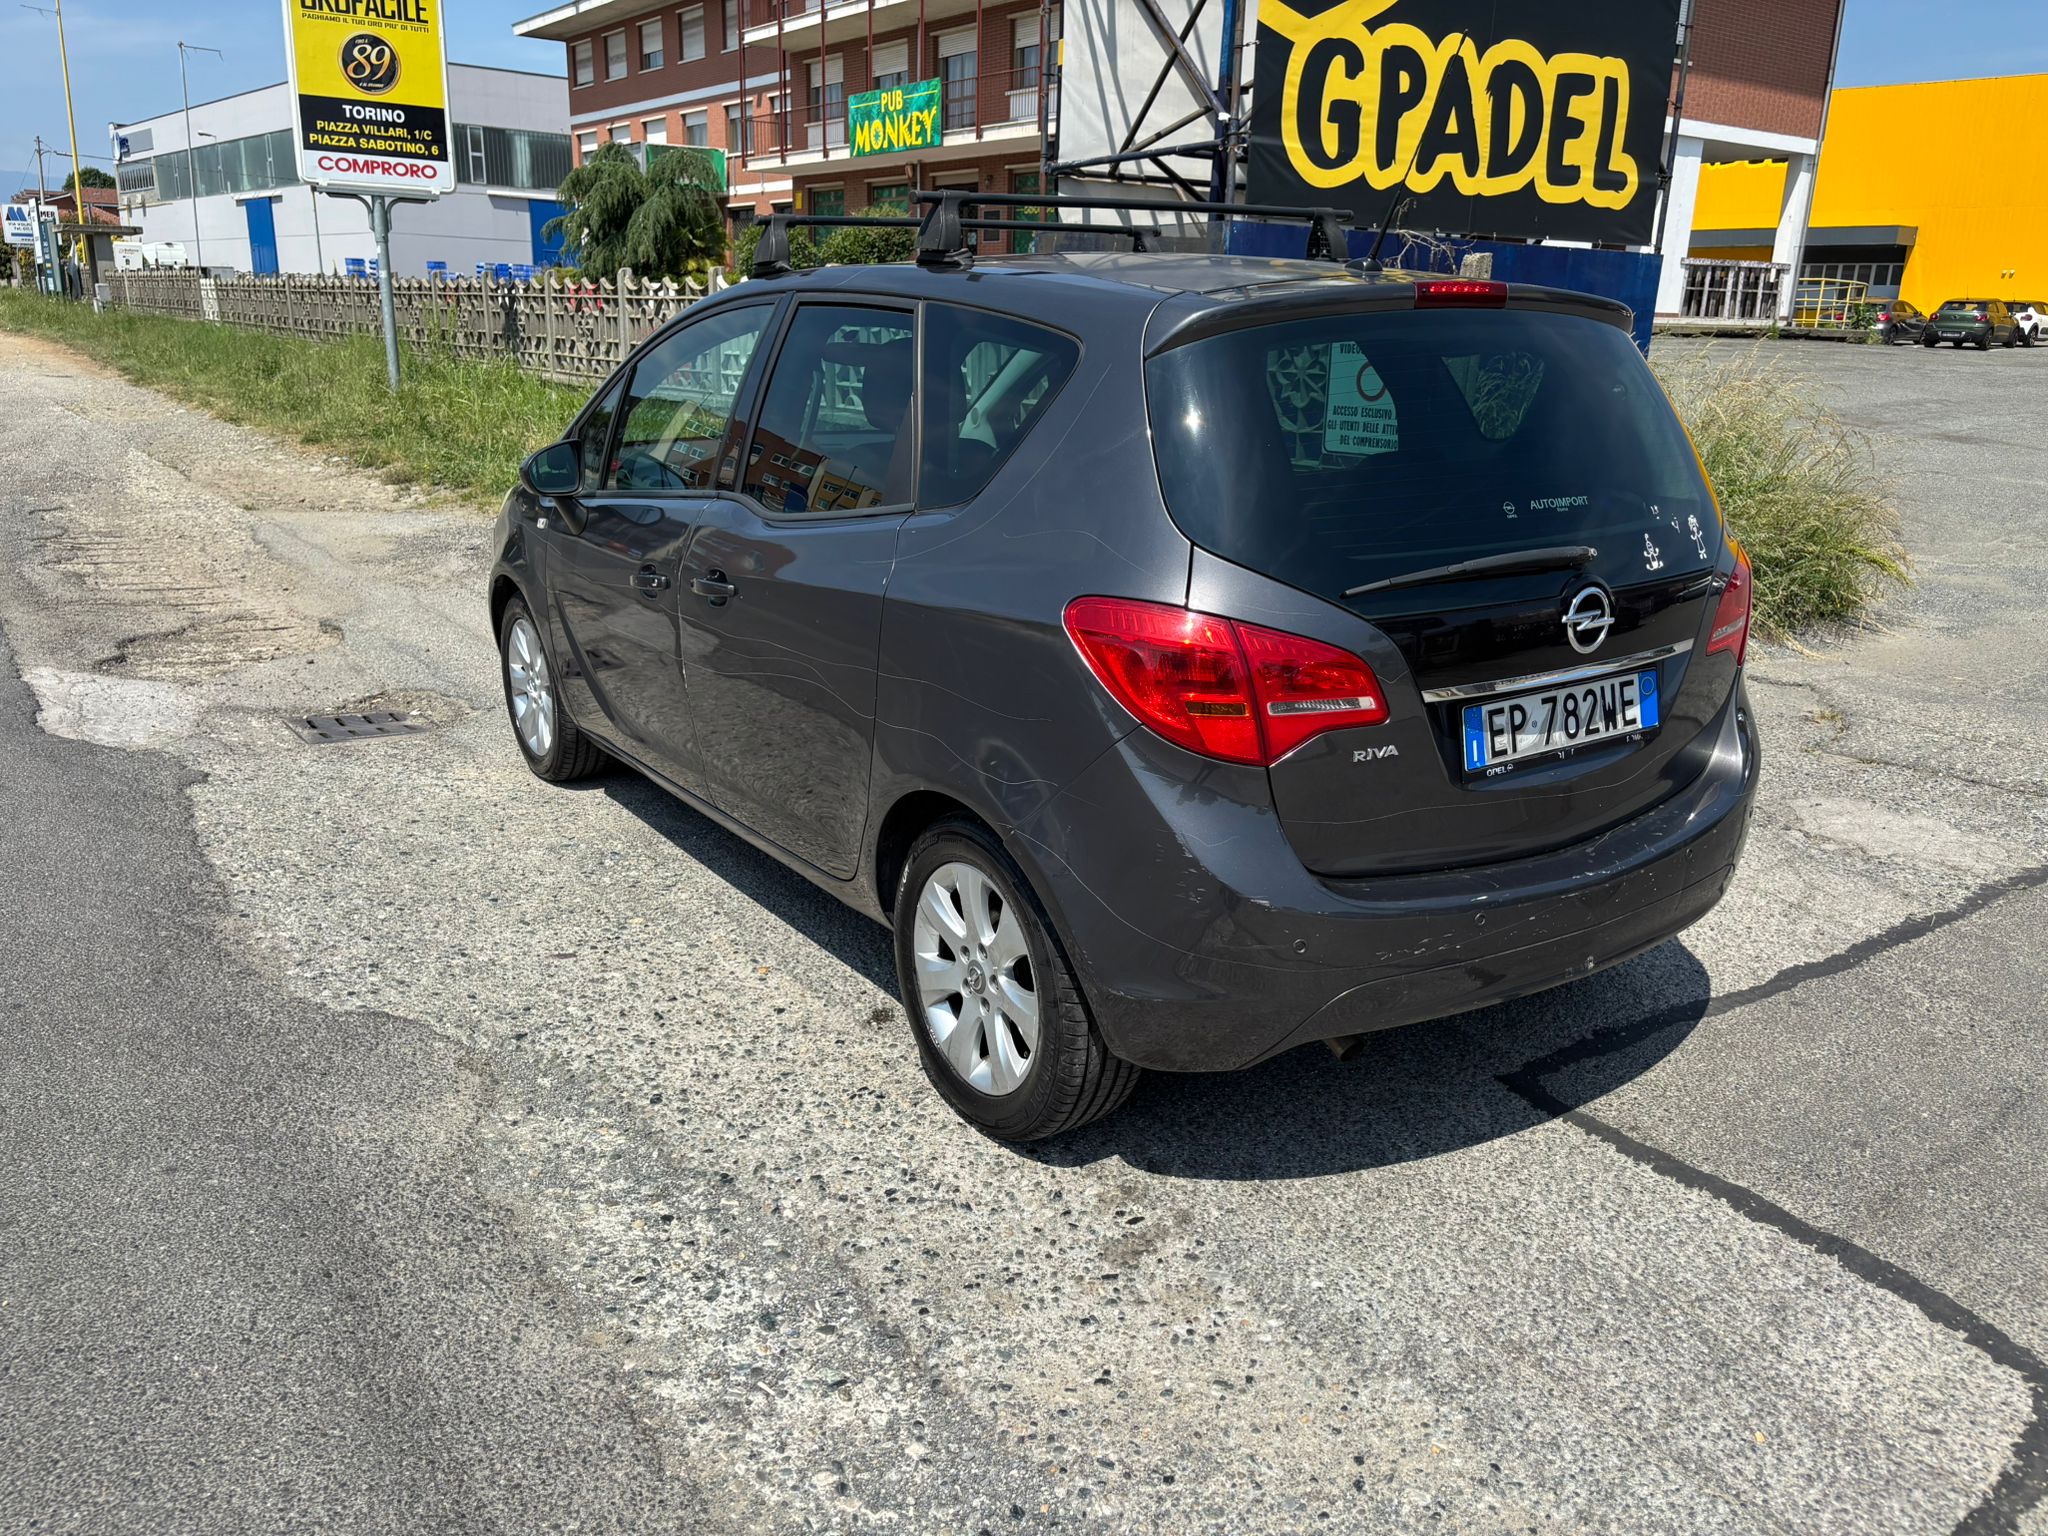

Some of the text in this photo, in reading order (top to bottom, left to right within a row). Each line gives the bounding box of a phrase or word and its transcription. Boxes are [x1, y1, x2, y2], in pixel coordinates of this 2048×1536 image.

[302, 12, 341, 23] PAGHIAMO
[352, 18, 366, 26] TUO
[367, 20, 383, 28] ORO
[410, 25, 430, 34] TUTTI
[347, 44, 392, 81] 89
[881, 89, 904, 113] PUB
[342, 104, 405, 123] TORINO
[1295, 37, 1629, 194] GPADEL
[316, 120, 433, 141] PIAZZA VILLARI, 1/C
[852, 105, 937, 157] MONKEY
[309, 133, 439, 156] PIAZZA SABOTINO, 6
[317, 155, 438, 180] COMPRORO
[1332, 405, 1393, 420] ACCESSO ESCLUSIVO
[1327, 419, 1337, 430] GLI
[1339, 420, 1360, 432] UTENTI
[1362, 422, 1380, 434] DELLE
[1339, 434, 1350, 445] DEL
[1530, 495, 1589, 510] AUTOIMPORT
[1486, 679, 1638, 759] EP 782WE
[1352, 744, 1399, 763] RIVA
